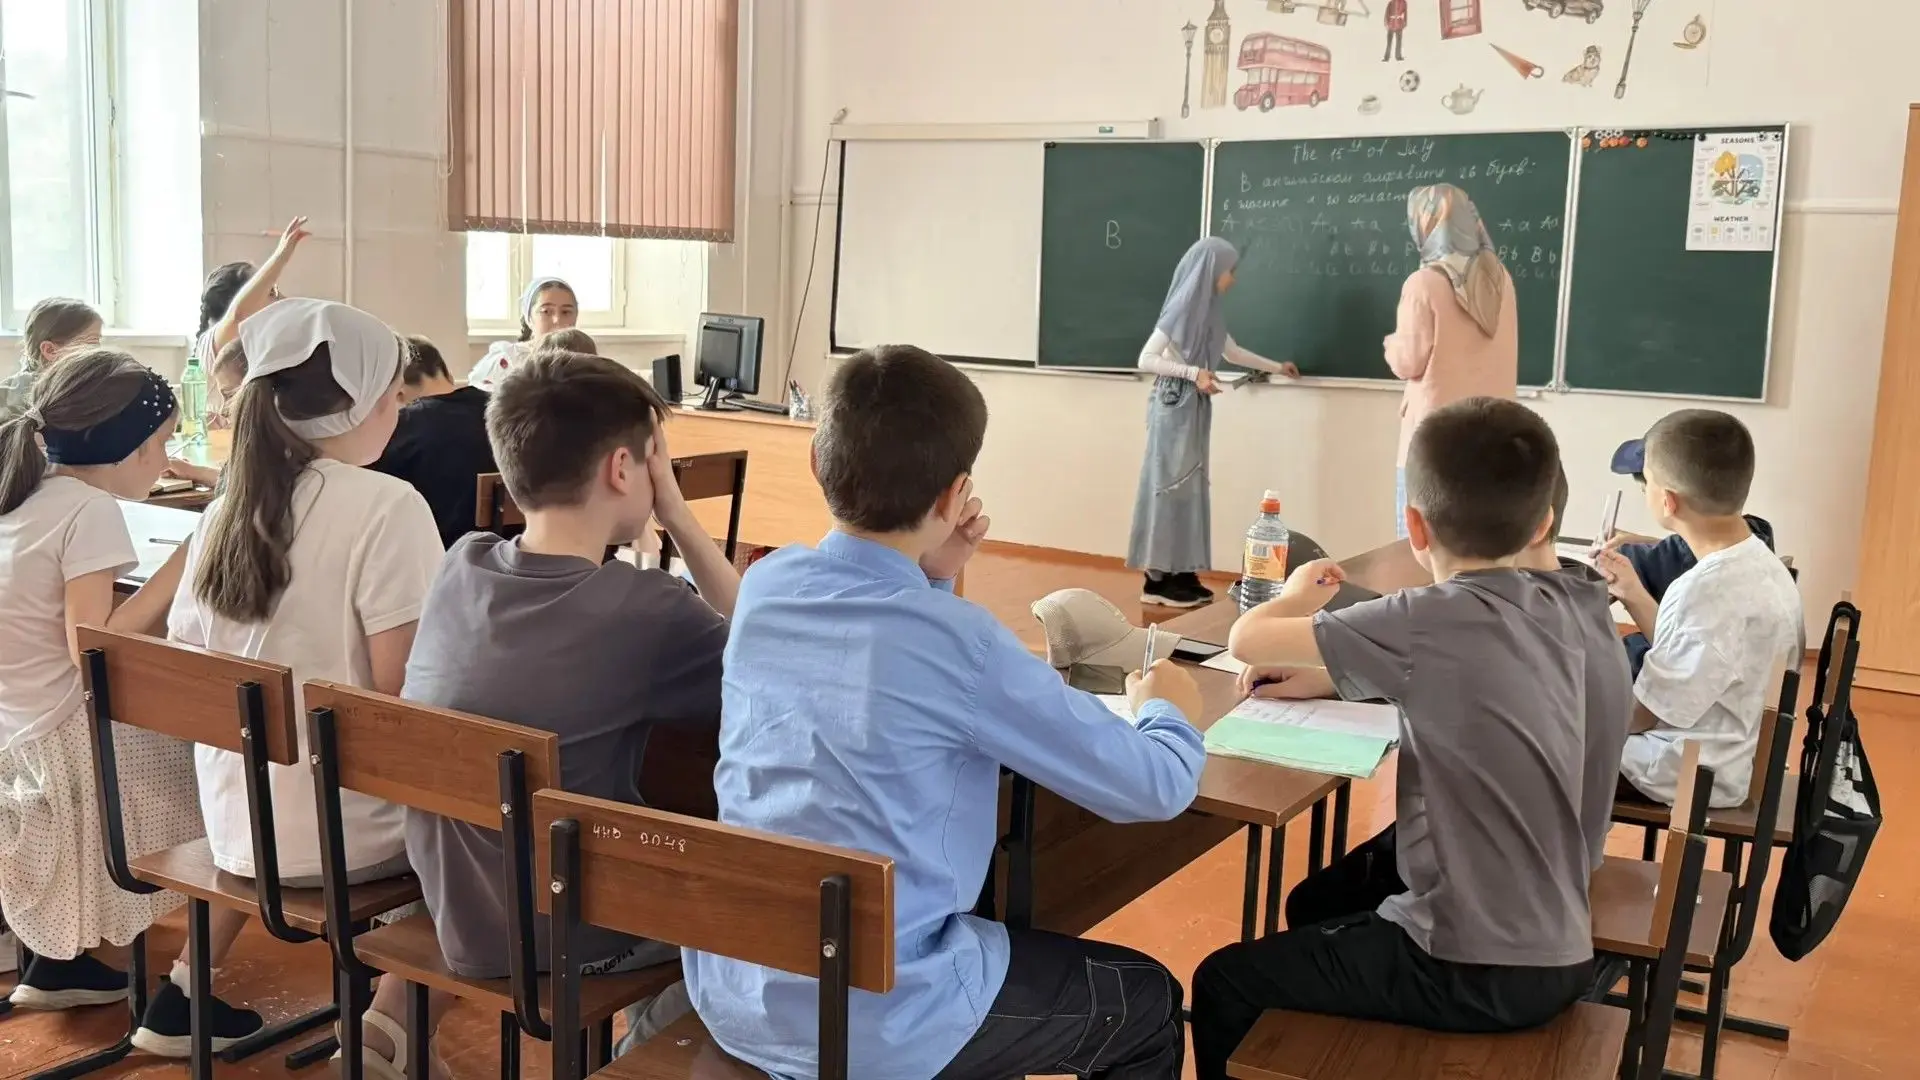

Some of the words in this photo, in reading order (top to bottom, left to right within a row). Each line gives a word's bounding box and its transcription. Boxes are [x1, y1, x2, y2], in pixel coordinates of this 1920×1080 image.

[1293, 142, 1317, 164] The
[1367, 139, 1388, 158] of
[1398, 138, 1434, 162] July
[1459, 165, 1476, 180] 26
